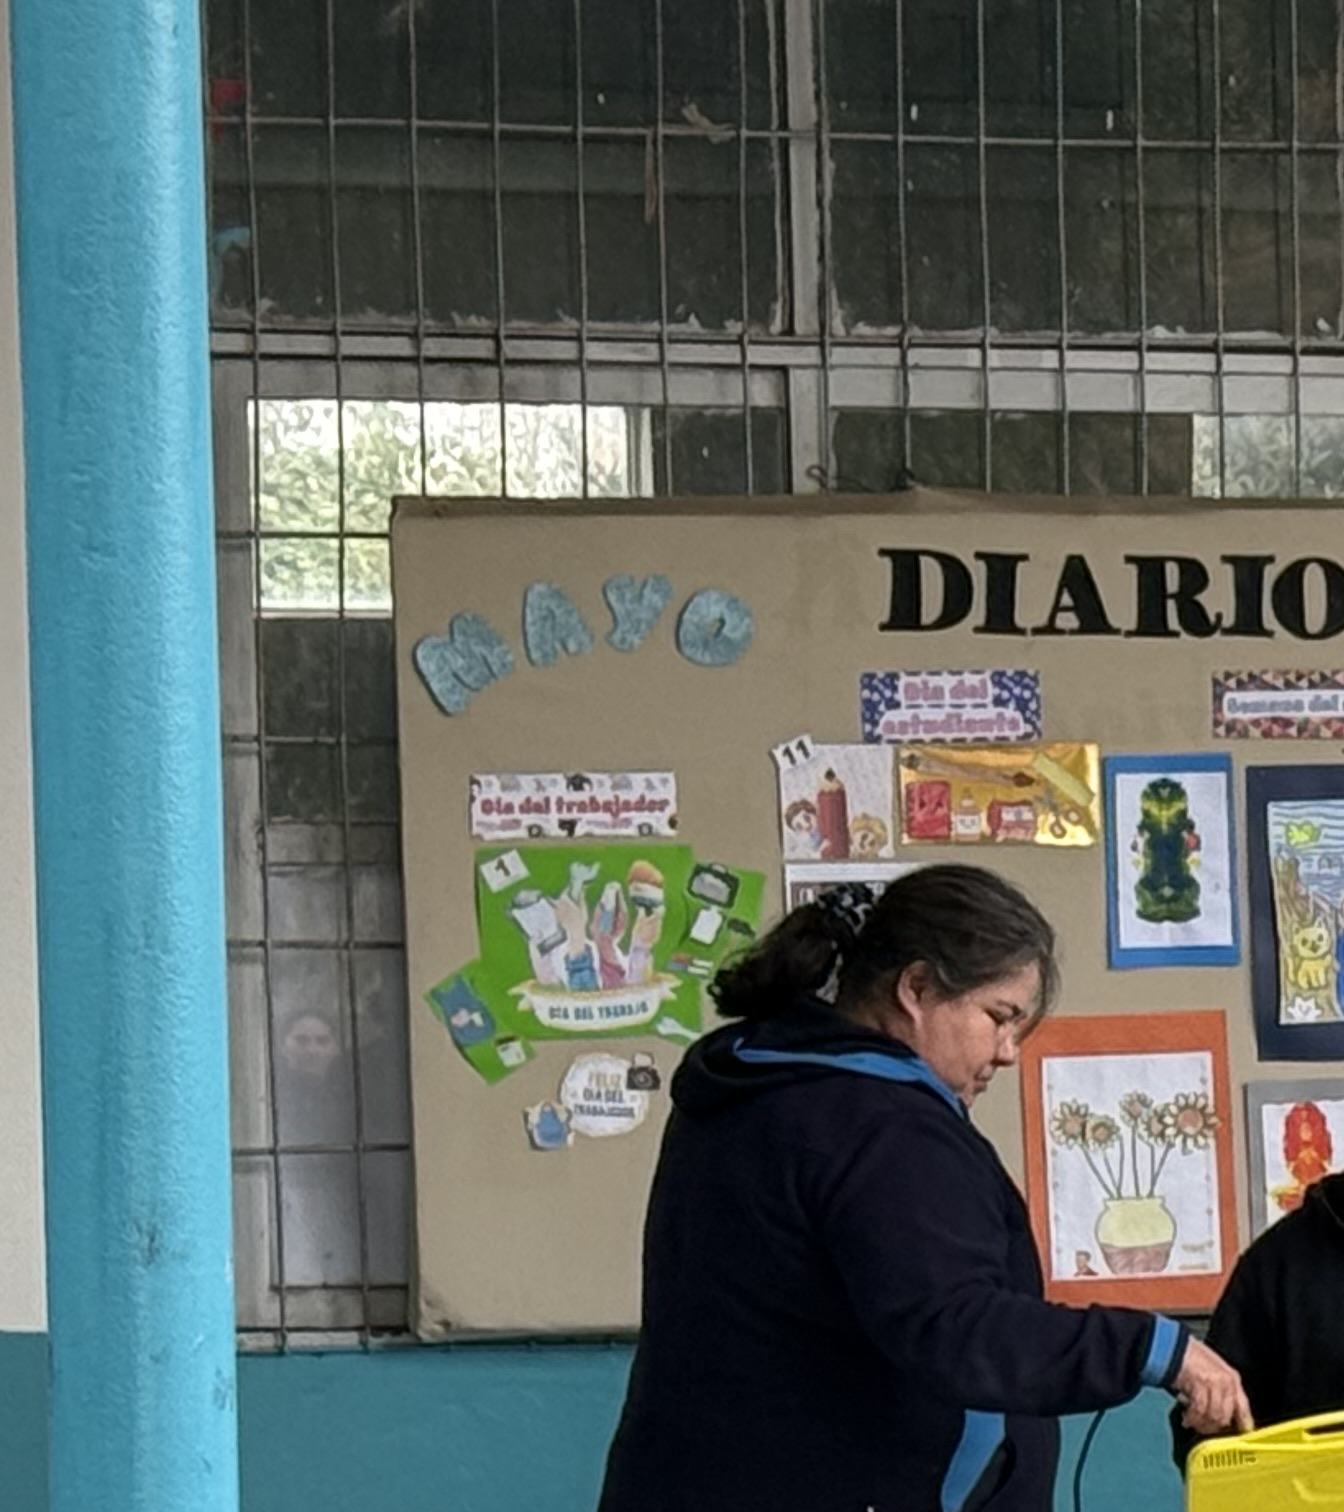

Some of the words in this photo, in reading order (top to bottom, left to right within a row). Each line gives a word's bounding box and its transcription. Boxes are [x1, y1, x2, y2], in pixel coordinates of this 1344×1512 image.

[412, 572, 755, 716] MAYO
[949, 678, 990, 700] del
[1226, 698, 1305, 714] Semana
[1308, 694, 1339, 713] del
[881, 711, 1022, 736] estudiante
[781, 739, 811, 766] 11
[519, 796, 550, 815] del
[555, 795, 670, 819] trabajador
[494, 858, 511, 877] 1
